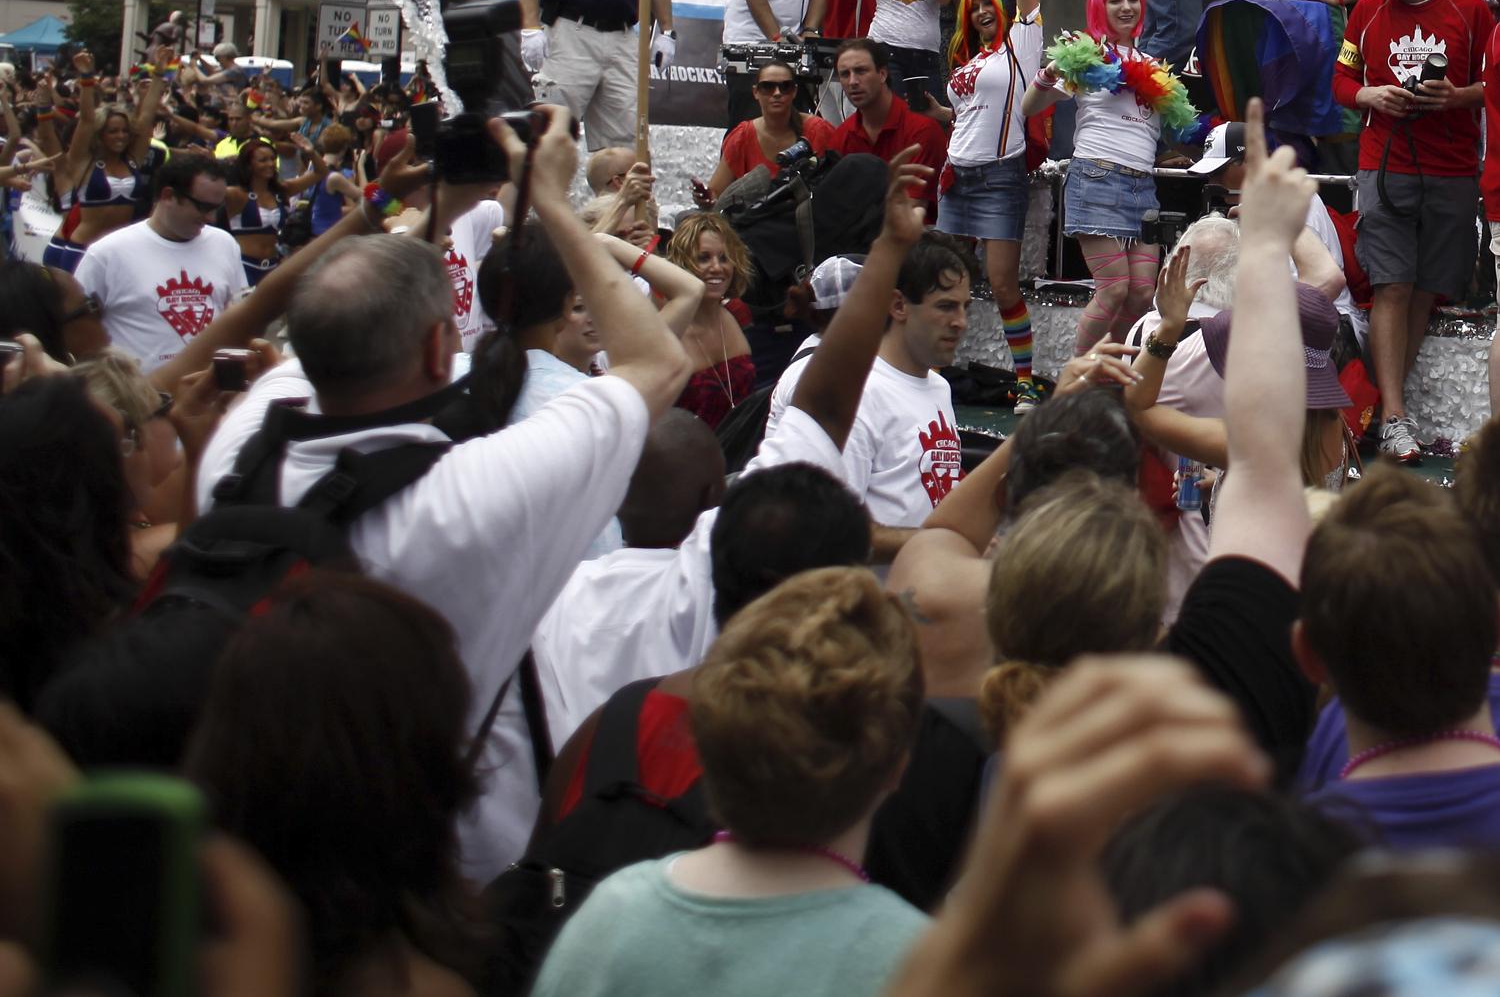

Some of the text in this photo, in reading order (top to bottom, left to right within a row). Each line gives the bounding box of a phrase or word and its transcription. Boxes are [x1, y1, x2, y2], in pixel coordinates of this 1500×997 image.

[334, 10, 351, 21] NO
[374, 27, 392, 36] TURN
[382, 40, 395, 49] RED
[1396, 53, 1429, 61] GAY HOCK
[931, 451, 943, 462] GAY
